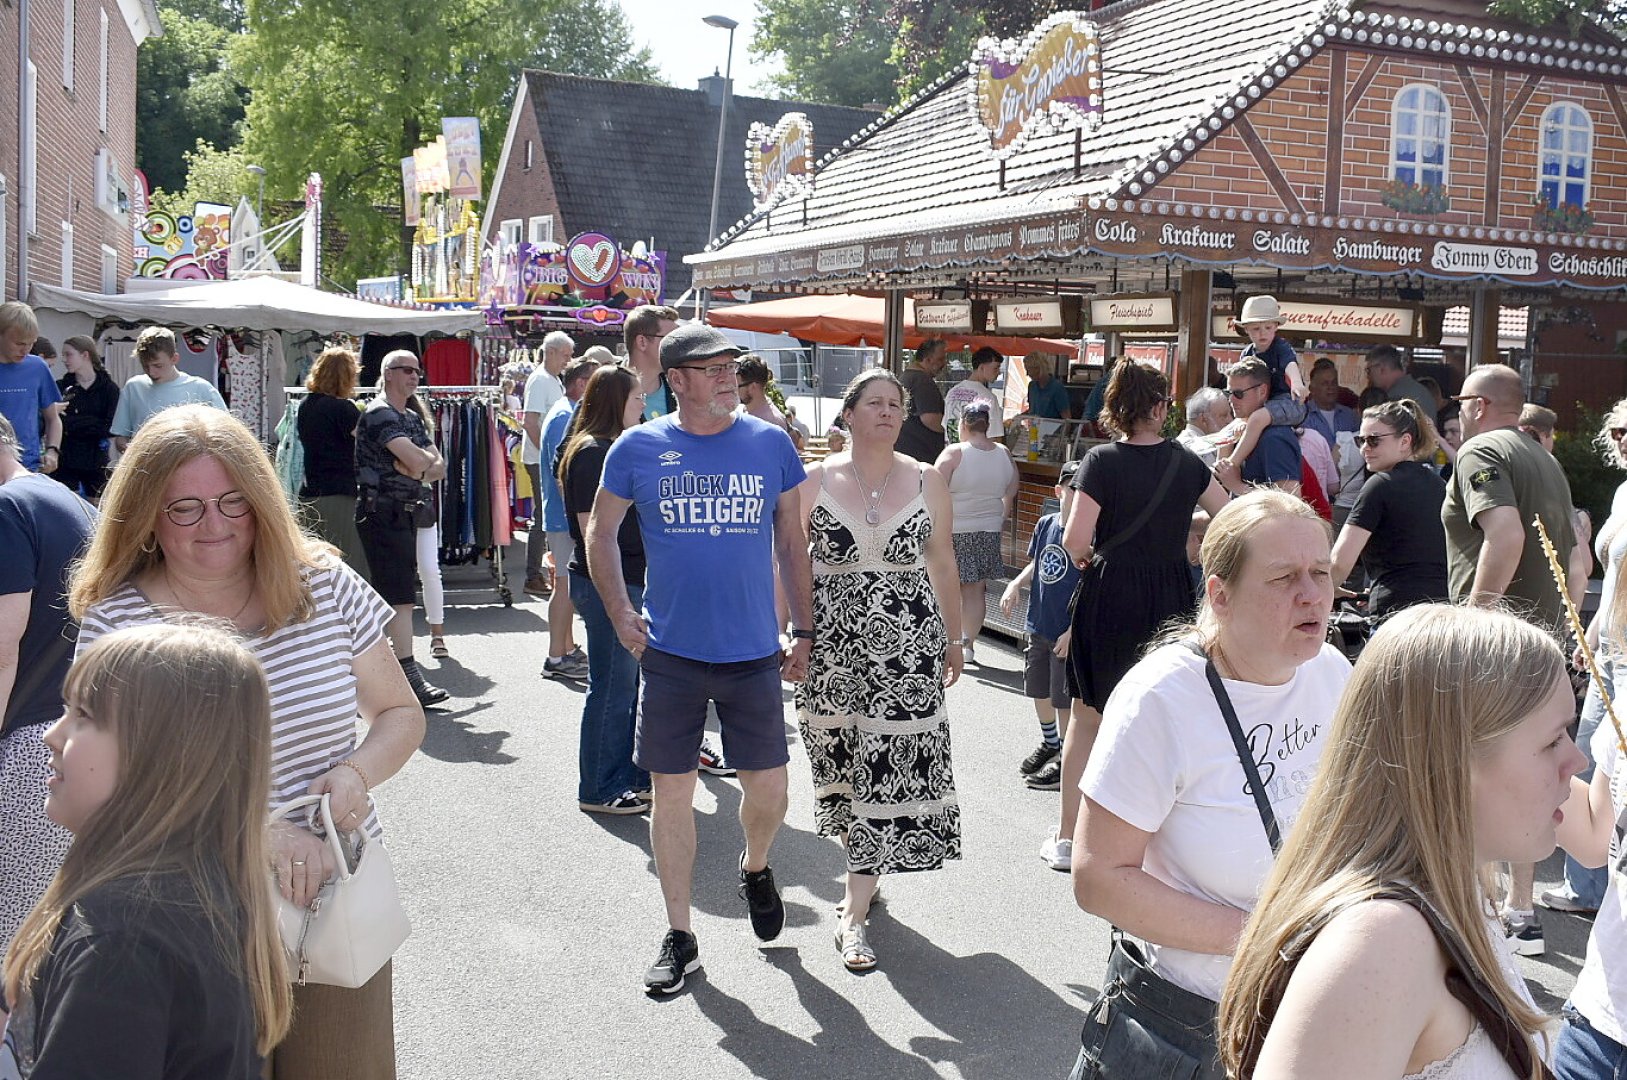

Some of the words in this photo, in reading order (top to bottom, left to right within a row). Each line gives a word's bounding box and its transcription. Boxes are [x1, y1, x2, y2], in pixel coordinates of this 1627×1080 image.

[996, 83, 1023, 138] für
[1019, 36, 1089, 127] Genießer
[1019, 221, 1055, 249] Pommes
[1058, 218, 1080, 246] frites
[1095, 218, 1136, 243] Cola
[1158, 223, 1235, 249] Krakauer
[1252, 230, 1310, 255] Salate
[1333, 237, 1423, 266] Hamburger
[1494, 248, 1532, 270] Eden
[534, 266, 568, 285] BIG
[619, 272, 660, 291] WIN
[1280, 310, 1401, 330] uernfrikadelle
[659, 470, 724, 499] GLÜCK
[728, 474, 764, 497] AUF
[659, 497, 764, 525] STEIGER!
[1243, 717, 1321, 795] Better
